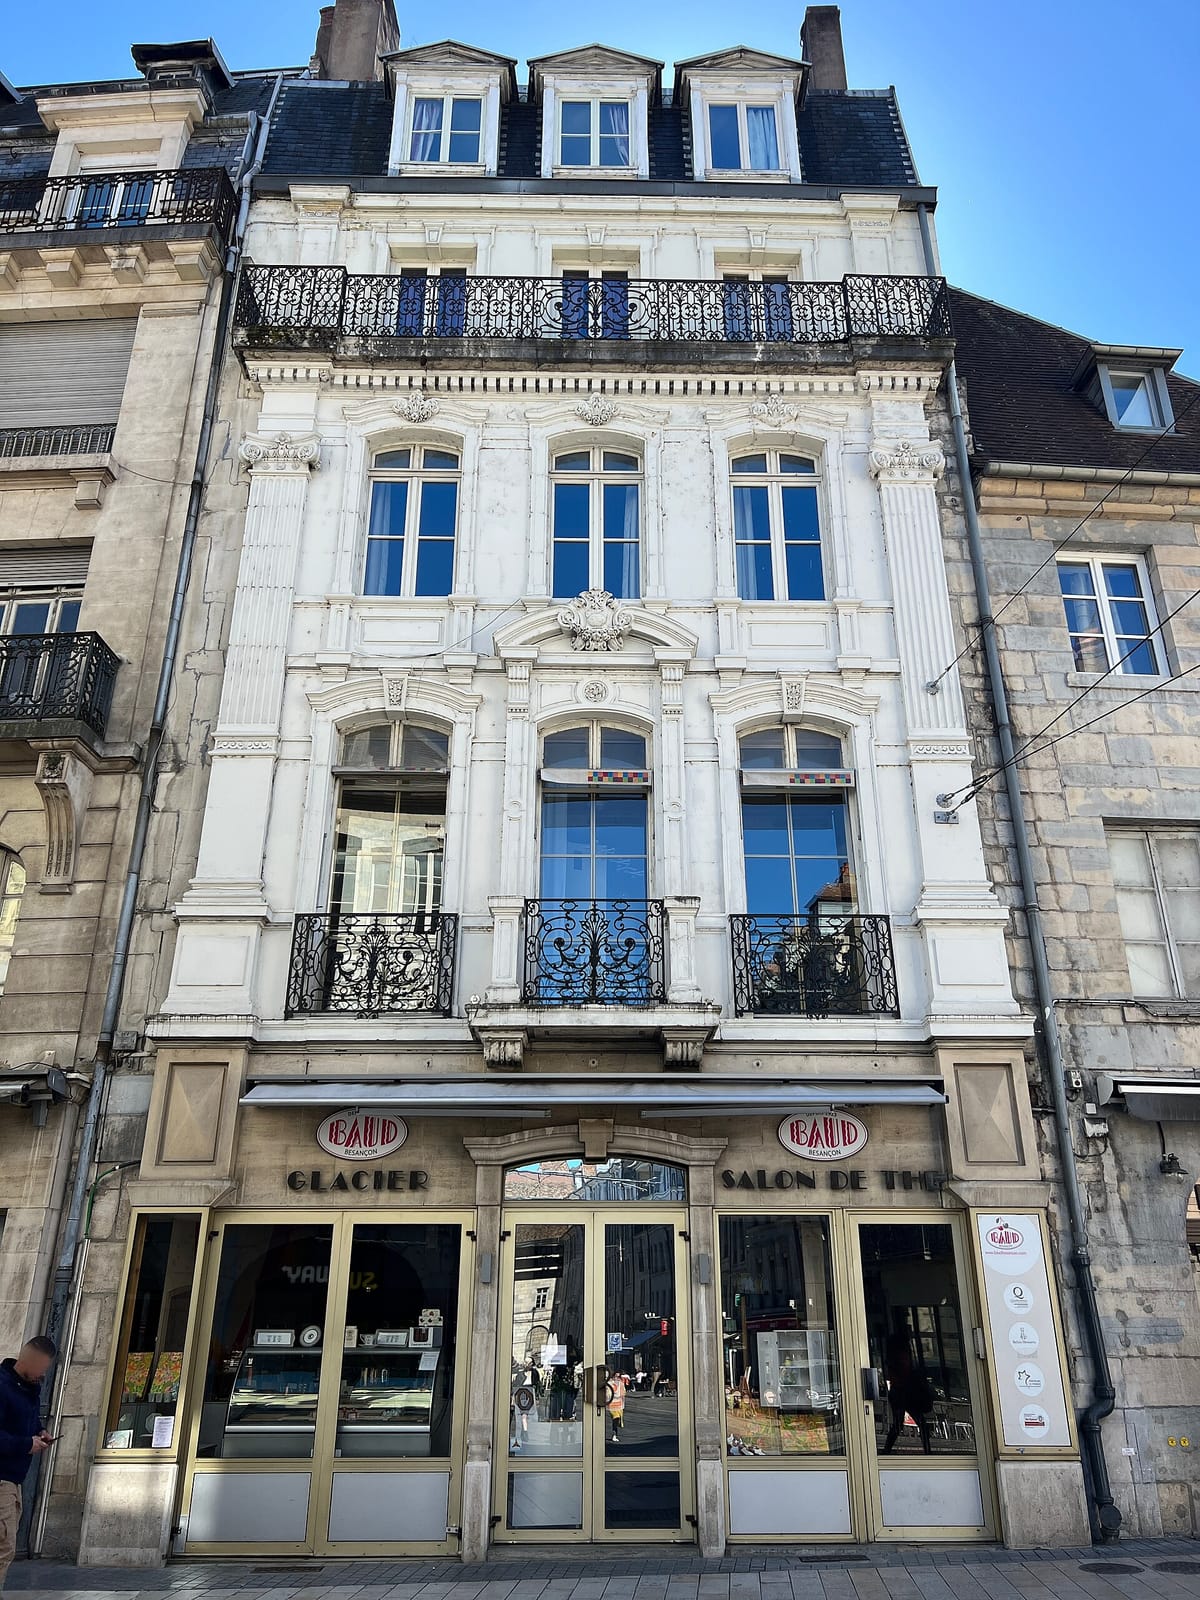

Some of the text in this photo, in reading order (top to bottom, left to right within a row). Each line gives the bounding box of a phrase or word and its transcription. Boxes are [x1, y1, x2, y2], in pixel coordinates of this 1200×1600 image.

[328, 1115, 398, 1148] BAUD
[789, 1116, 858, 1149] BAUD
[344, 1148, 378, 1157] BESANÇON
[808, 1149, 842, 1158] BESANÇON
[287, 1170, 430, 1191] GLACIER
[722, 1169, 816, 1190] SALON
[830, 1170, 868, 1190] DE
[990, 1231, 1020, 1245] BAUD
